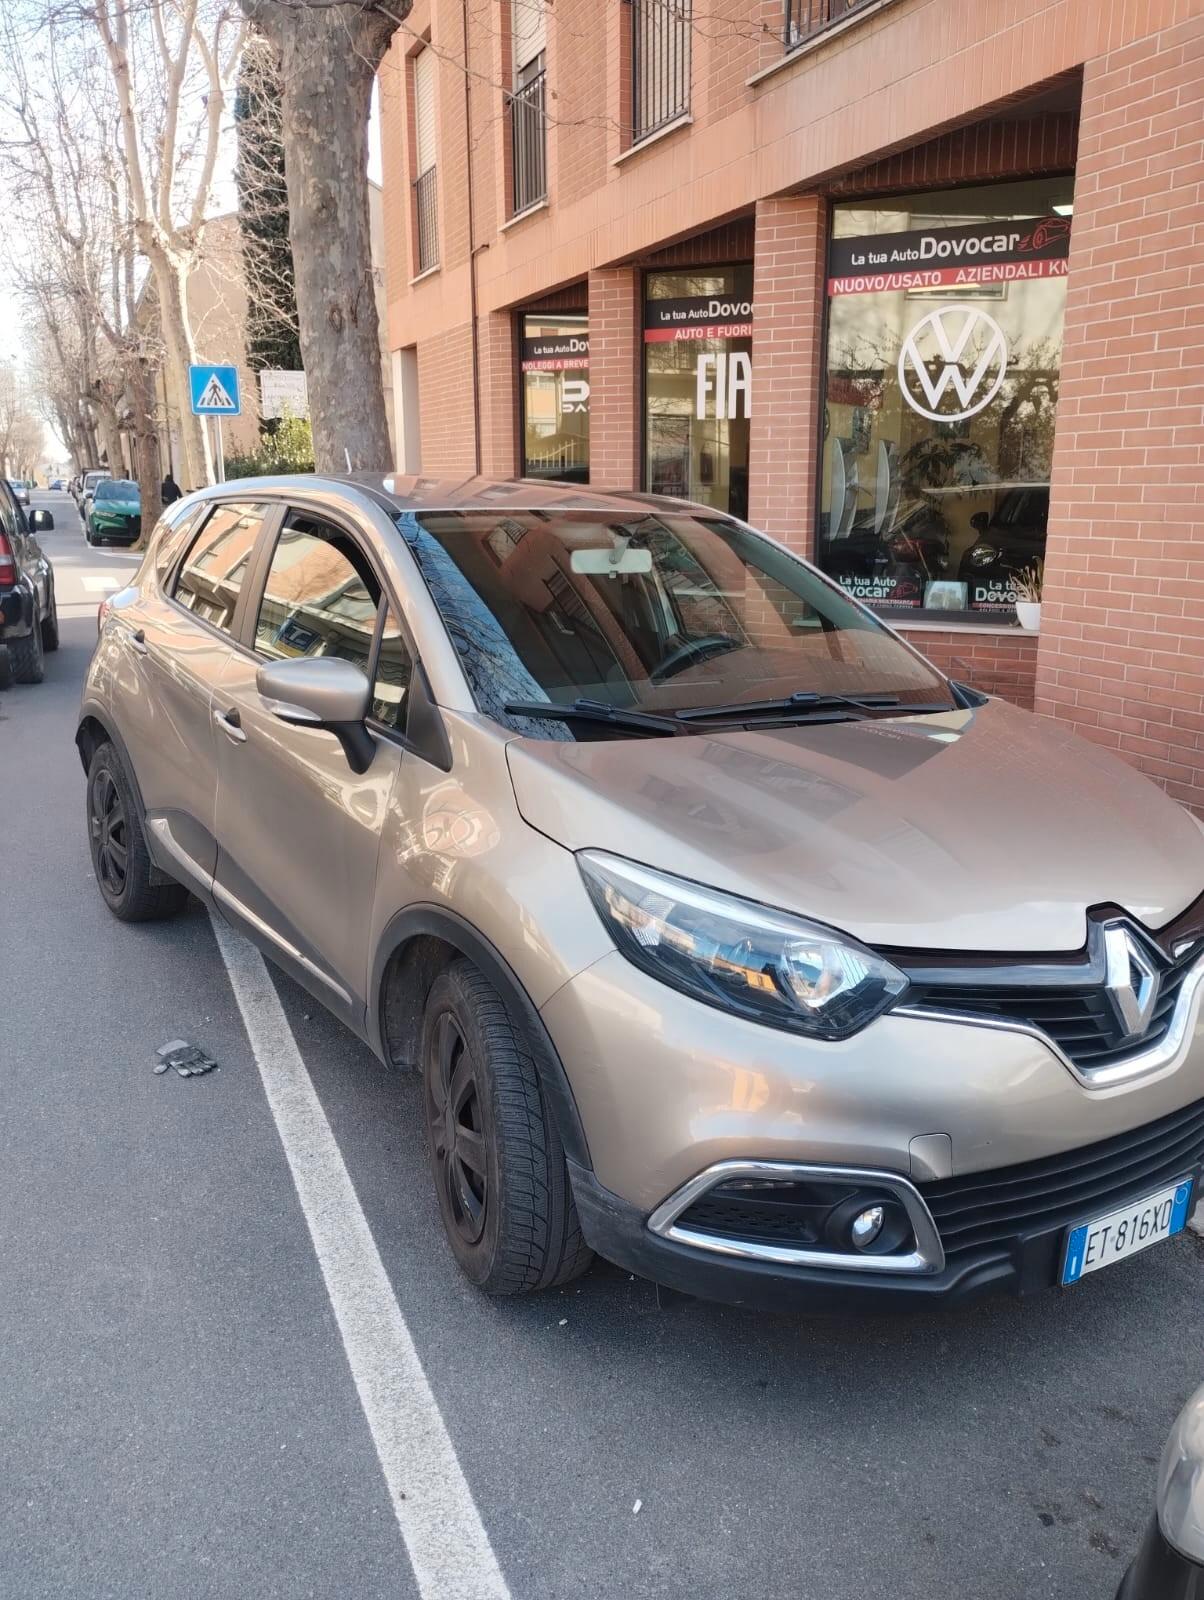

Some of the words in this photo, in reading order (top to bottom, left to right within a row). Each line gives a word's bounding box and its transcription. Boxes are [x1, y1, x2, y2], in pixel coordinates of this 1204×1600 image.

[851, 253, 865, 266] La
[868, 251, 888, 264] tua
[890, 249, 919, 262] Auto
[919, 233, 1020, 260] Dovocar
[833, 272, 942, 293] NUOVO/USATO
[955, 264, 1043, 284] AZIENDALI
[660, 311, 671, 321] La
[673, 310, 686, 320] tua
[688, 308, 708, 319] Auto
[708, 300, 754, 318] Dovo
[675, 328, 703, 340] AUTO
[707, 326, 714, 338] E
[717, 324, 752, 337] FUORI
[534, 346, 542, 355] La
[543, 345, 554, 354] tua
[556, 360, 562, 369] A
[563, 359, 589, 369] BREVE
[839, 576, 852, 585] La
[855, 577, 870, 585] tua
[873, 577, 897, 587] Auto
[989, 580, 1002, 590] La
